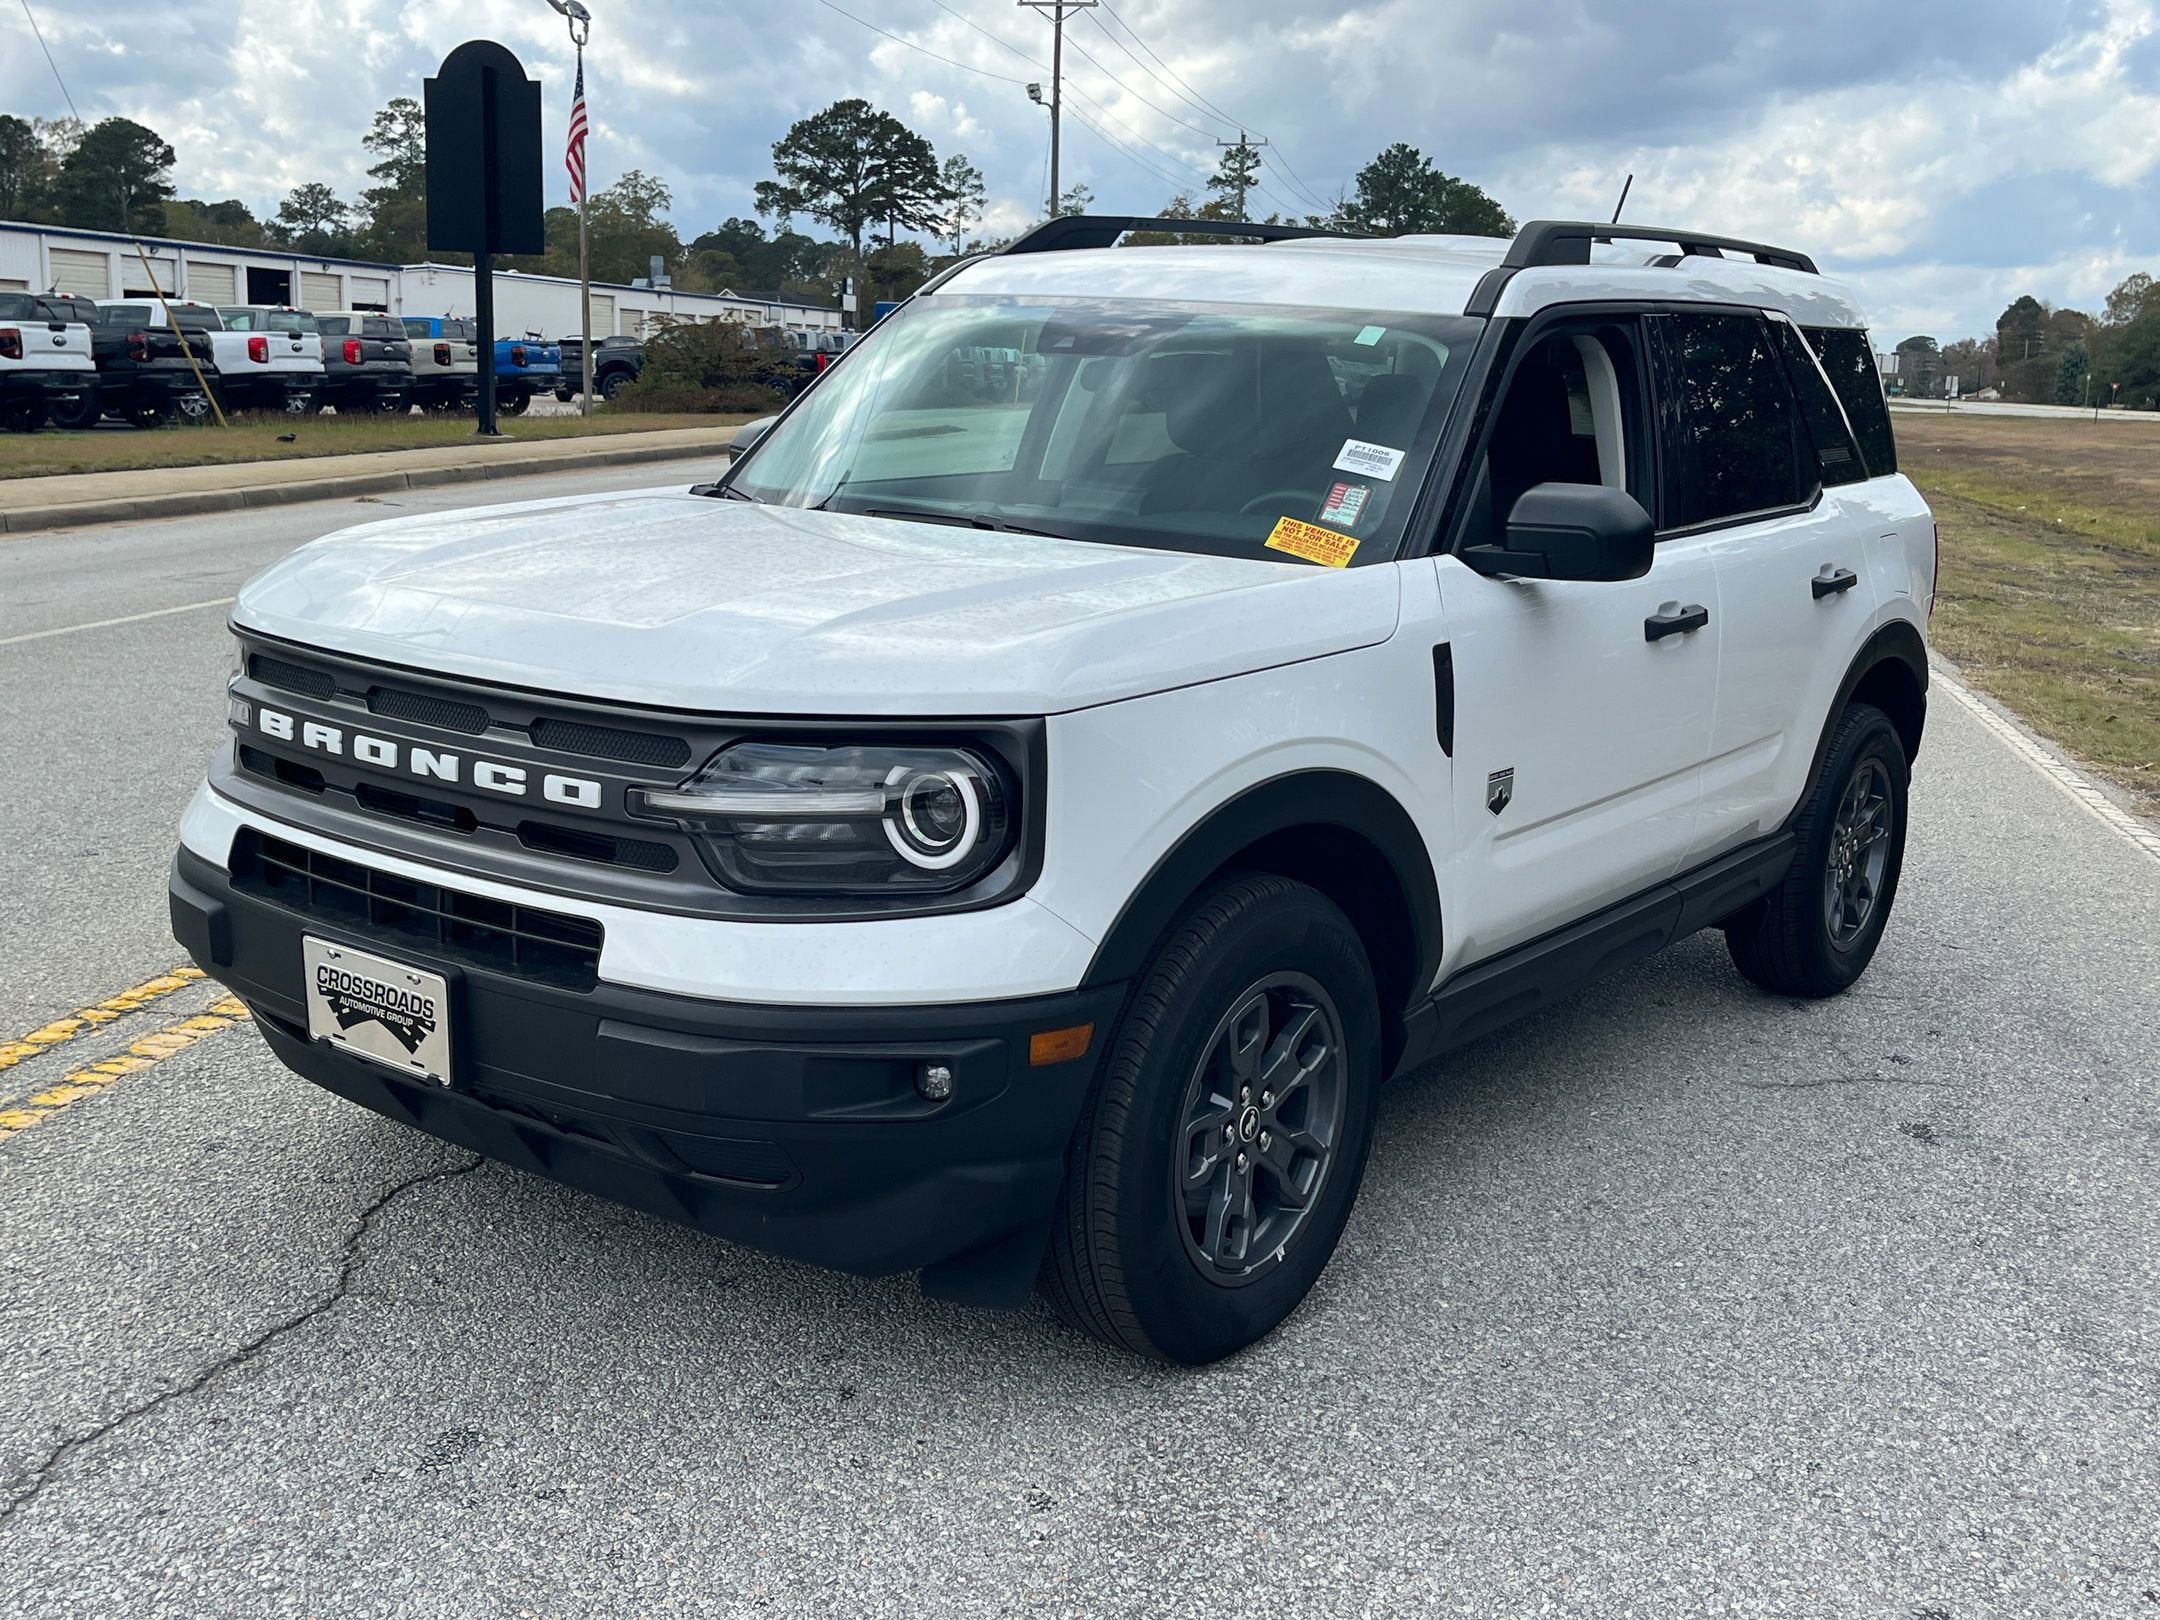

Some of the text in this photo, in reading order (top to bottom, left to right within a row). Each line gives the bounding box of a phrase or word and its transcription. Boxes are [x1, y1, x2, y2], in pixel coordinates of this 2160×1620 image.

[1282, 519, 1303, 529] THIS
[1304, 525, 1344, 542] VEHICLE
[1282, 526, 1348, 550] NOT FOR SALE
[259, 708, 602, 809] BRONCO
[317, 966, 434, 1019] CROSSROADS
[339, 996, 414, 1027] AUTOMOTIVE GROUP
